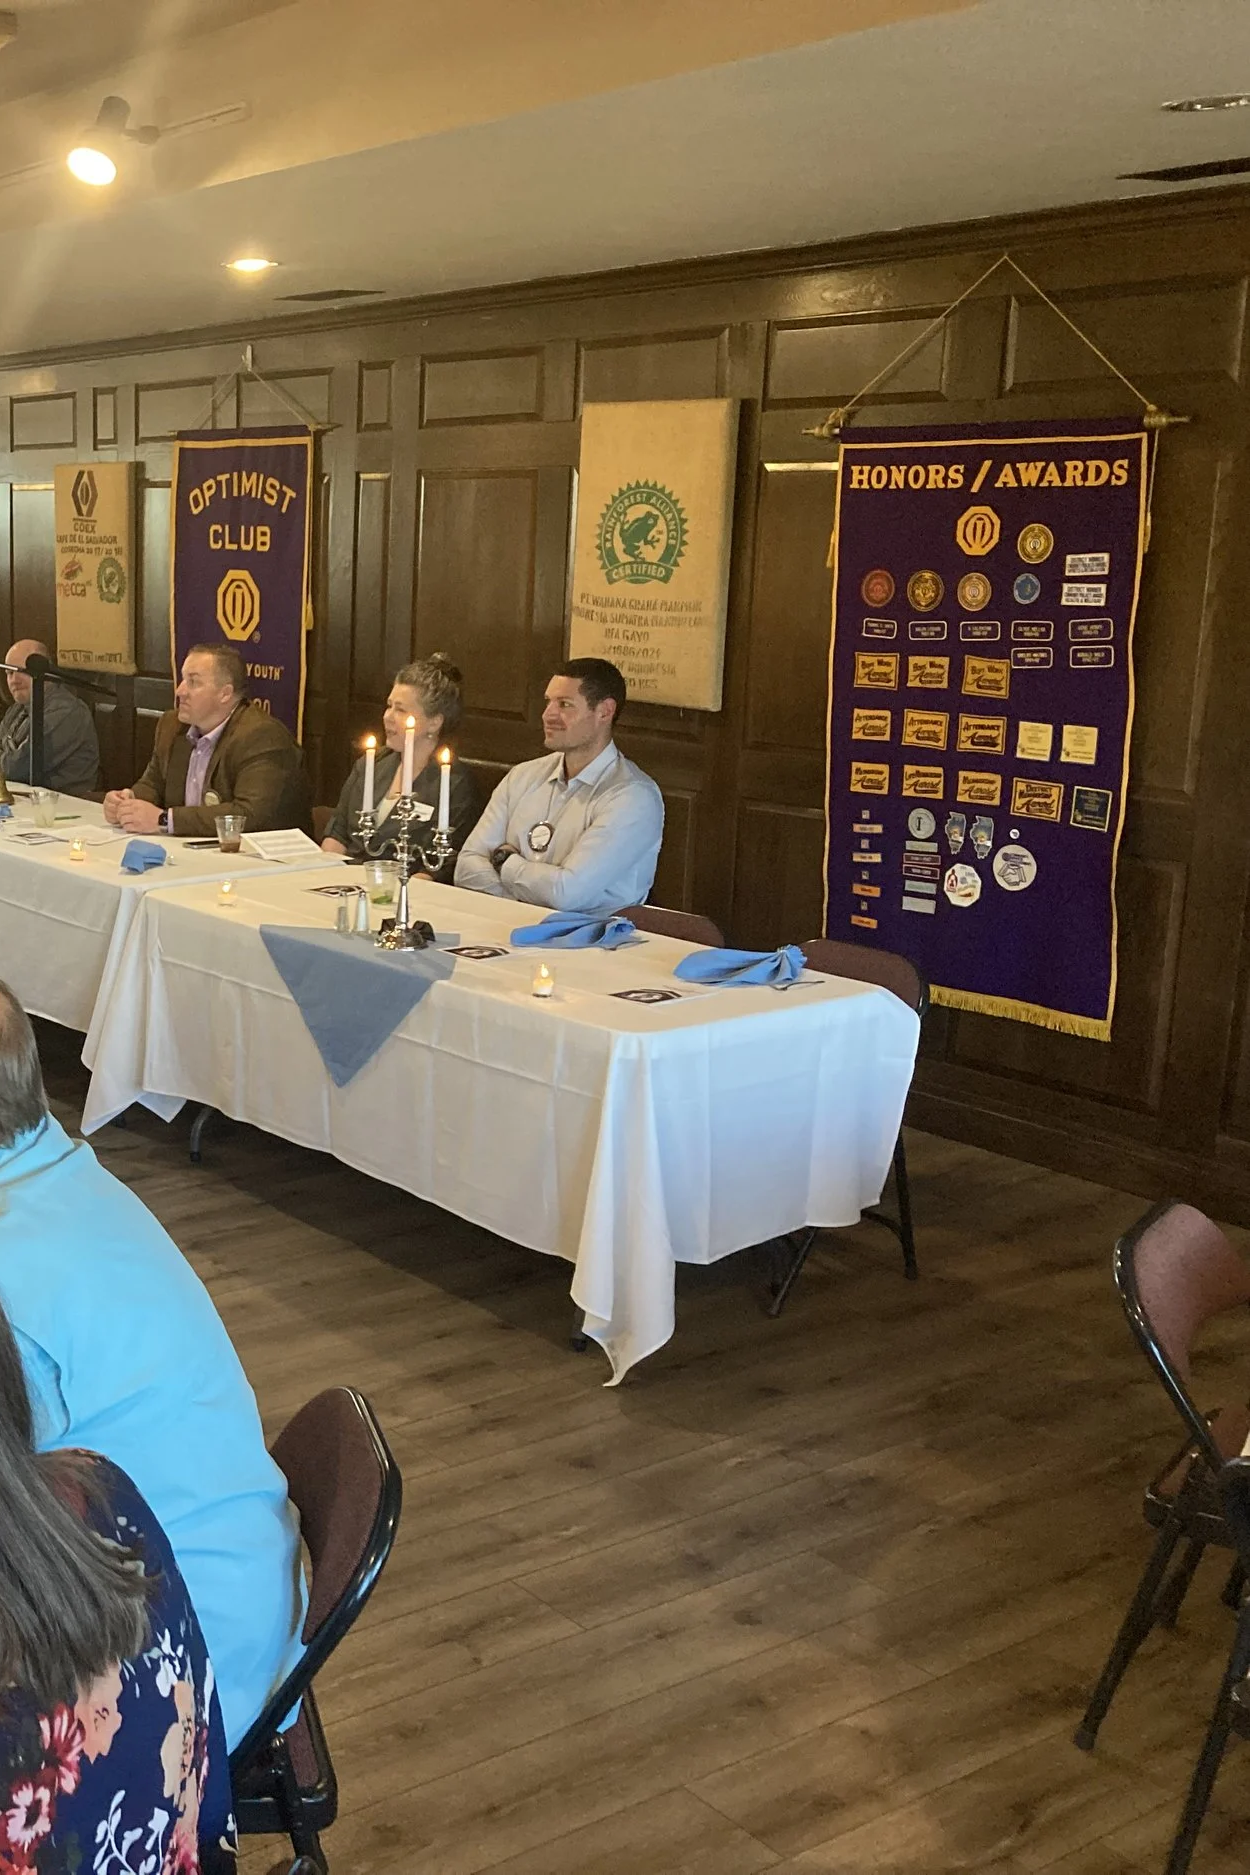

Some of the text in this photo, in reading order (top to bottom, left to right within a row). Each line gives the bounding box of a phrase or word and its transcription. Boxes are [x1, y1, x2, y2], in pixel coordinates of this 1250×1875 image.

[849, 463, 964, 489] HONORS
[994, 458, 1129, 488] AWARDS
[188, 470, 297, 515] OPTIMIST
[604, 493, 677, 548] RAINFOREST ALLIANCE
[85, 535, 118, 545] SALVADOR
[209, 523, 271, 552] CLUB
[612, 563, 666, 579] CERTIFIED
